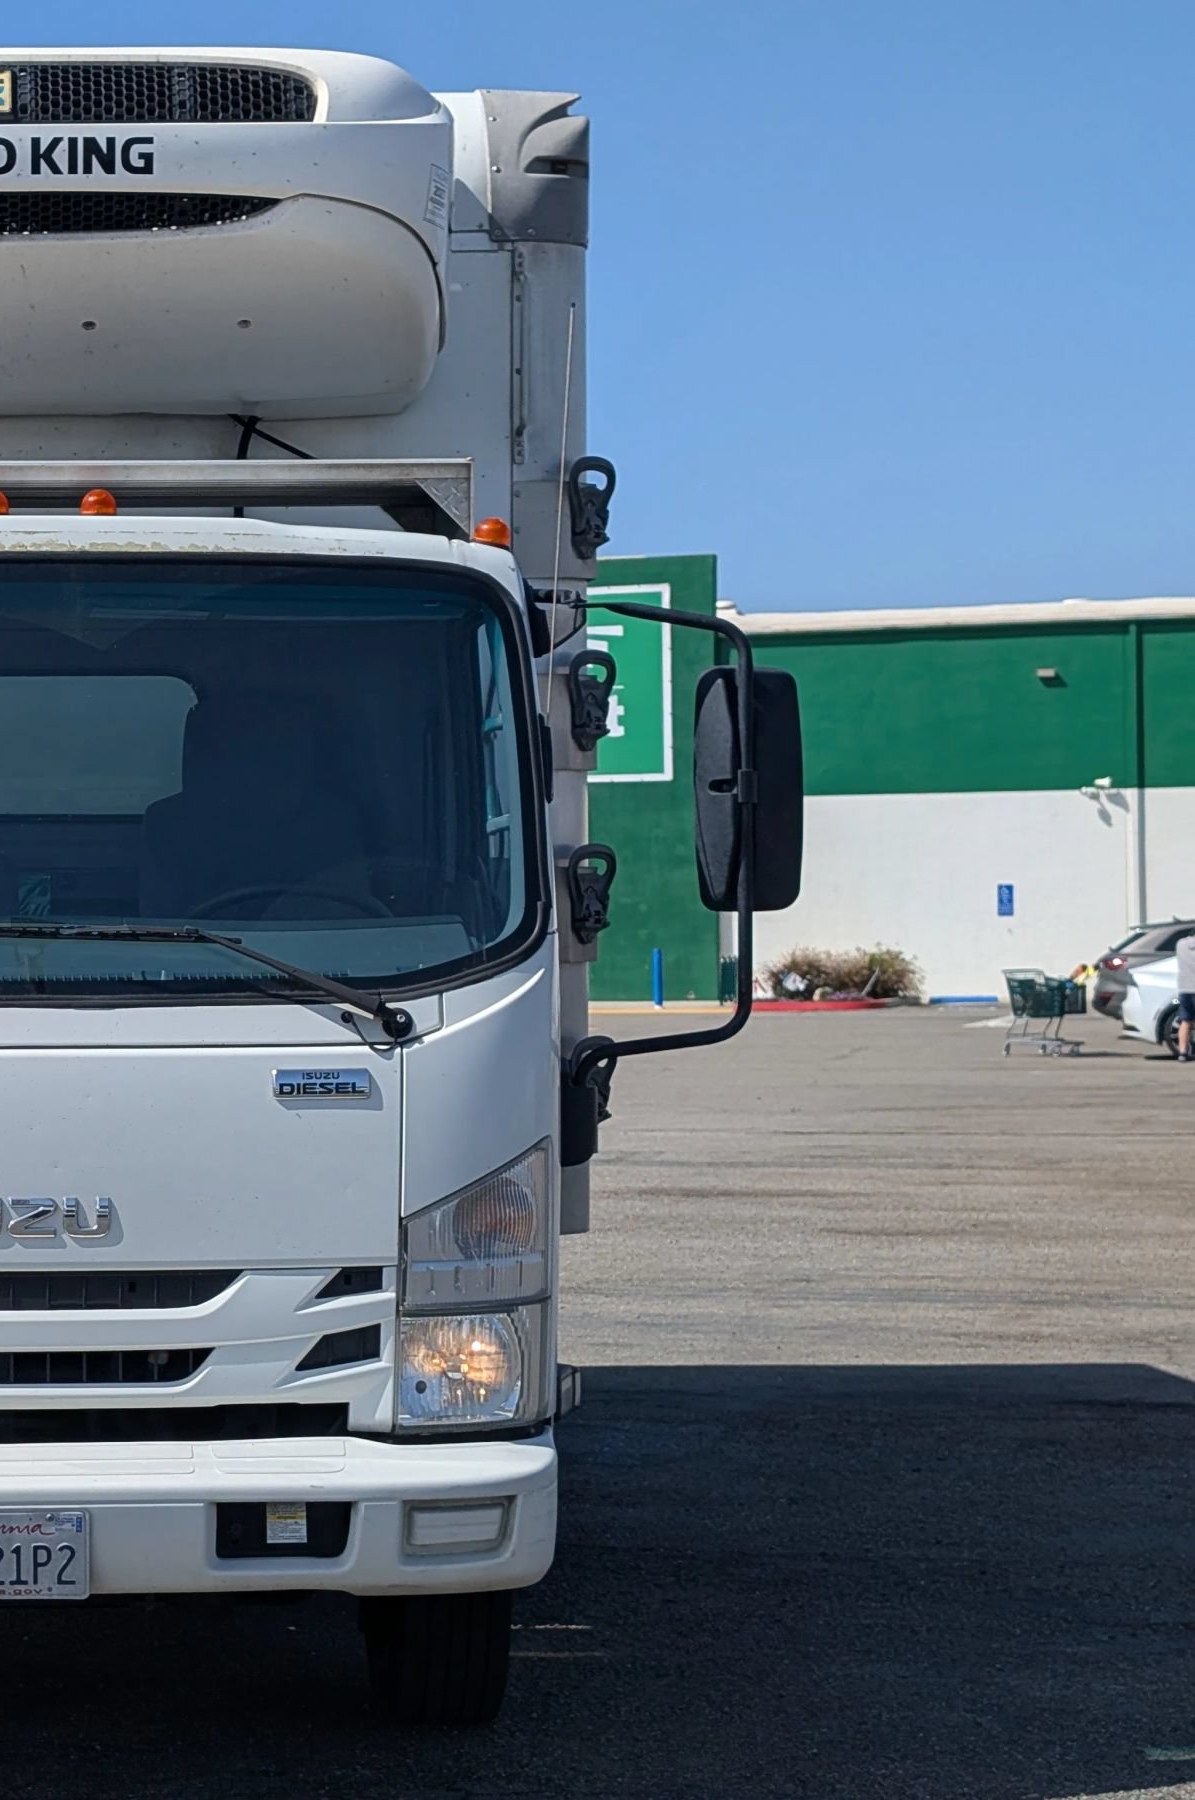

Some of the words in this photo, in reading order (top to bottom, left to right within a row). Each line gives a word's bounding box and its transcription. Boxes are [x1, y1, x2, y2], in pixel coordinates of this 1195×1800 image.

[30, 137, 154, 175] KING
[302, 1071, 340, 1080] ISUZU
[278, 1082, 369, 1095] DIESEL
